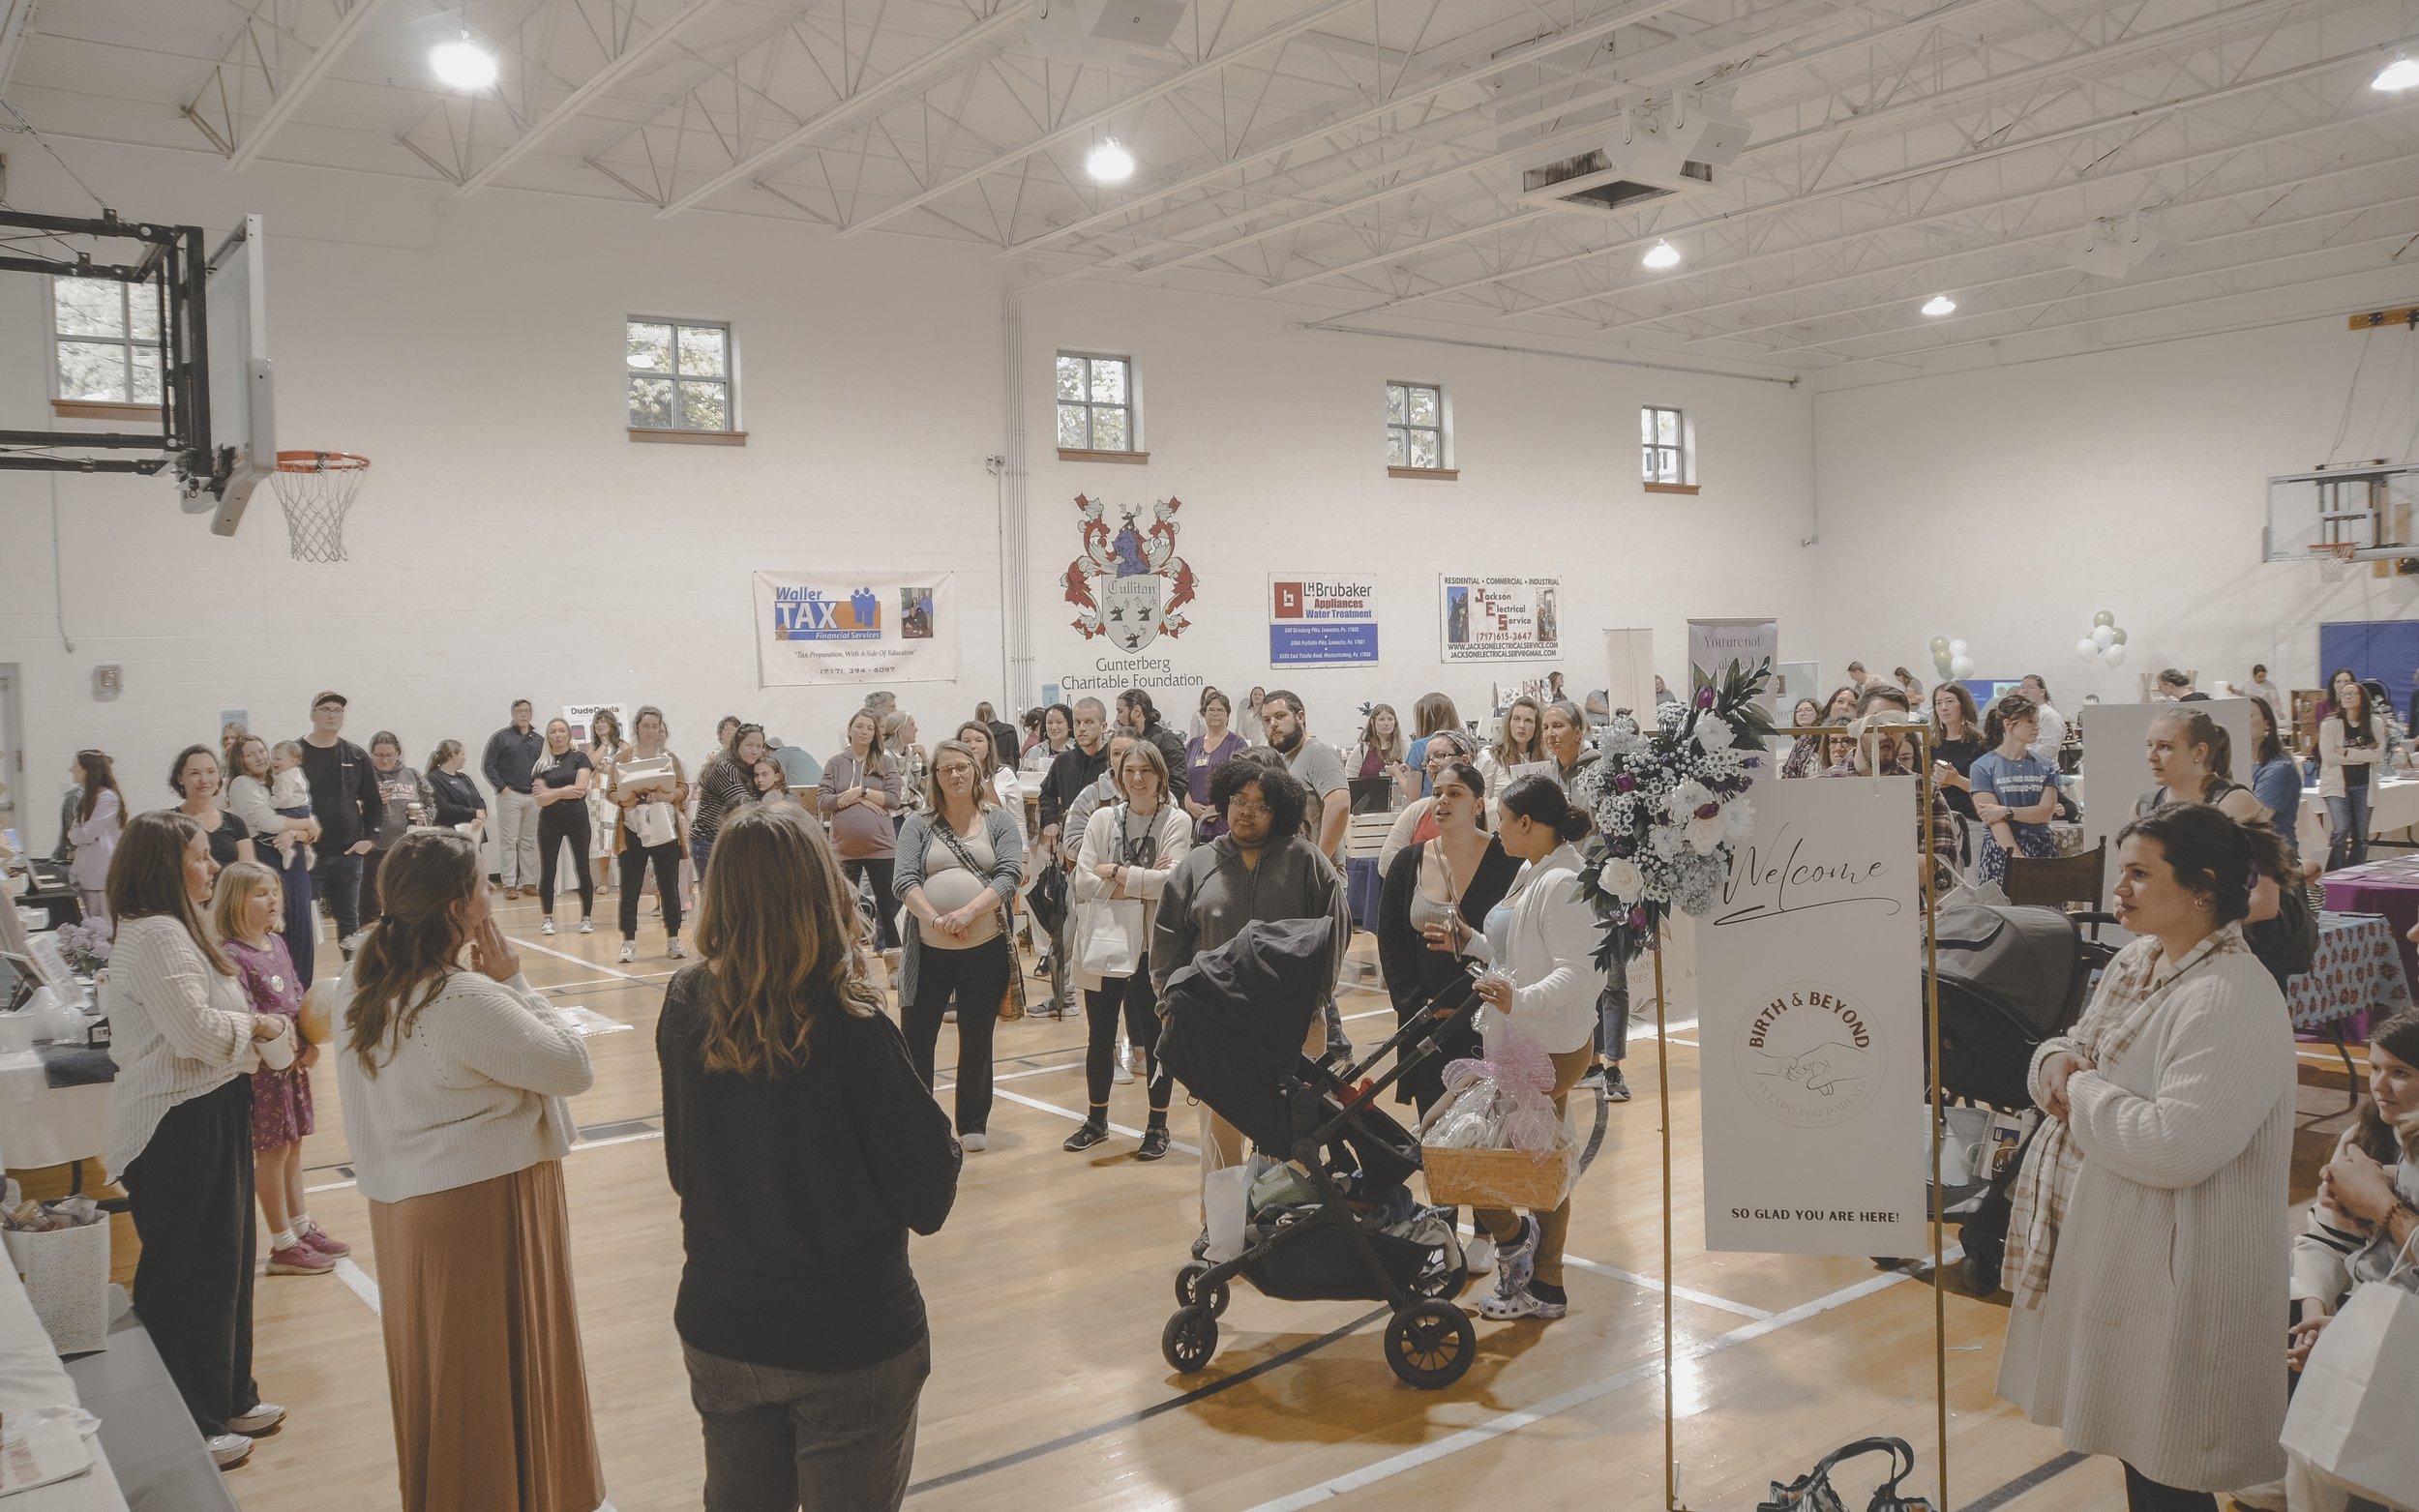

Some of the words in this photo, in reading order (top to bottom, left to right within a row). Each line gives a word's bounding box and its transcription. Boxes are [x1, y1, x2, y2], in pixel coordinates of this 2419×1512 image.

[776, 586, 822, 601] Waller
[1108, 580, 1156, 595] Culliton
[1316, 582, 1372, 597] Brubaker
[1475, 588, 1511, 603] Jackson
[1314, 599, 1363, 609] Appliances
[1485, 602, 1526, 616] Electrical
[776, 602, 839, 629] TAX
[1306, 609, 1329, 618] Water
[1331, 609, 1372, 618] Treatment
[1498, 614, 1532, 631] Service
[851, 631, 880, 639] Services
[1476, 633, 1532, 641] (717)615-3647
[1704, 636, 1725, 648] You
[1727, 639, 1743, 648] are
[1745, 636, 1761, 647] not
[1095, 657, 1171, 672] Gunterberg
[1061, 674, 1129, 690] Charitable
[1133, 673, 1204, 687] Foundation
[1722, 821, 1889, 912] Welcome
[1748, 993, 1788, 1050] BIRTH
[1791, 992, 1804, 1008] &
[1809, 991, 1870, 1050] BEYOND
[1731, 1208, 1750, 1219] SO
[1753, 1208, 1791, 1220] GLAD
[1796, 1209, 1825, 1221] YOU
[1828, 1210, 1855, 1222] ARE
[1860, 1210, 1900, 1224] HERE!
